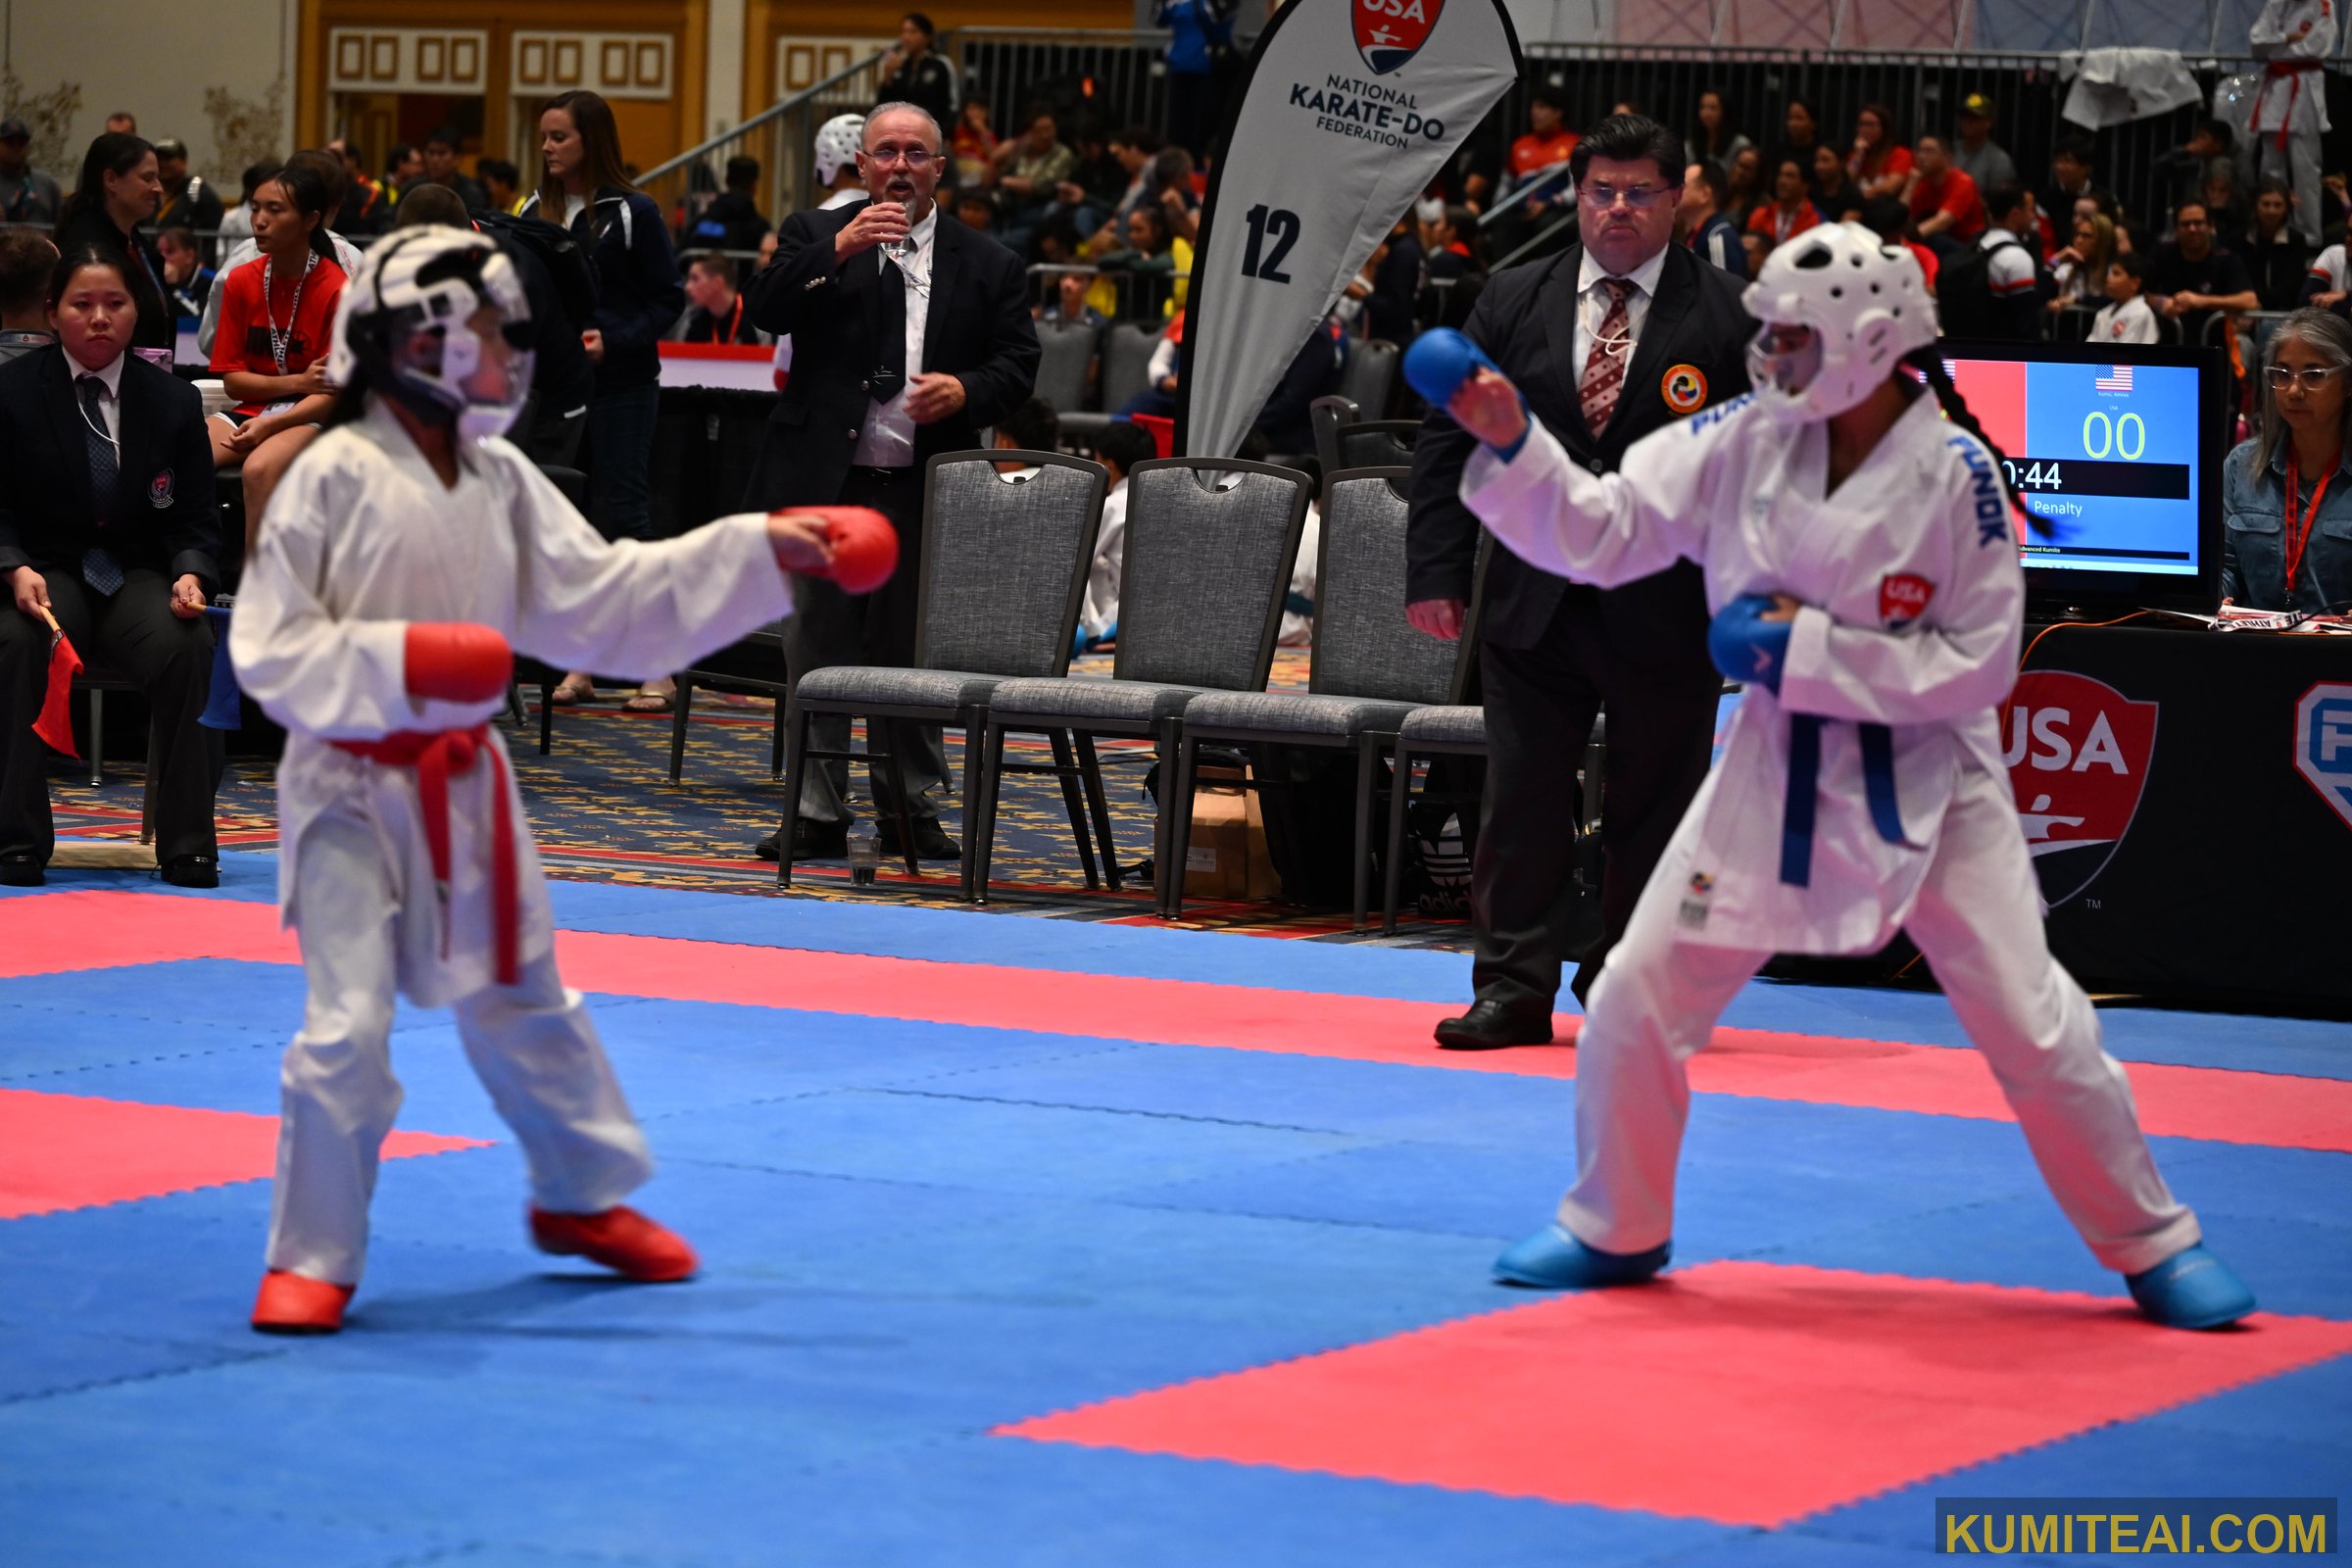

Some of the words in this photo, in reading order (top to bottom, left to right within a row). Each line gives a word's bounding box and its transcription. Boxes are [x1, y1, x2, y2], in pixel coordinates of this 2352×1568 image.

[1326, 74, 1418, 110] NATIONAL
[1290, 83, 1445, 140] KARATE-DO
[1316, 117, 1408, 149] FEDERATION
[1242, 204, 1300, 284] 12
[2082, 412, 2145, 461] 00
[2034, 501, 2082, 517] Penalty
[1419, 890, 1472, 910] adid
[2086, 899, 2101, 909] TM
